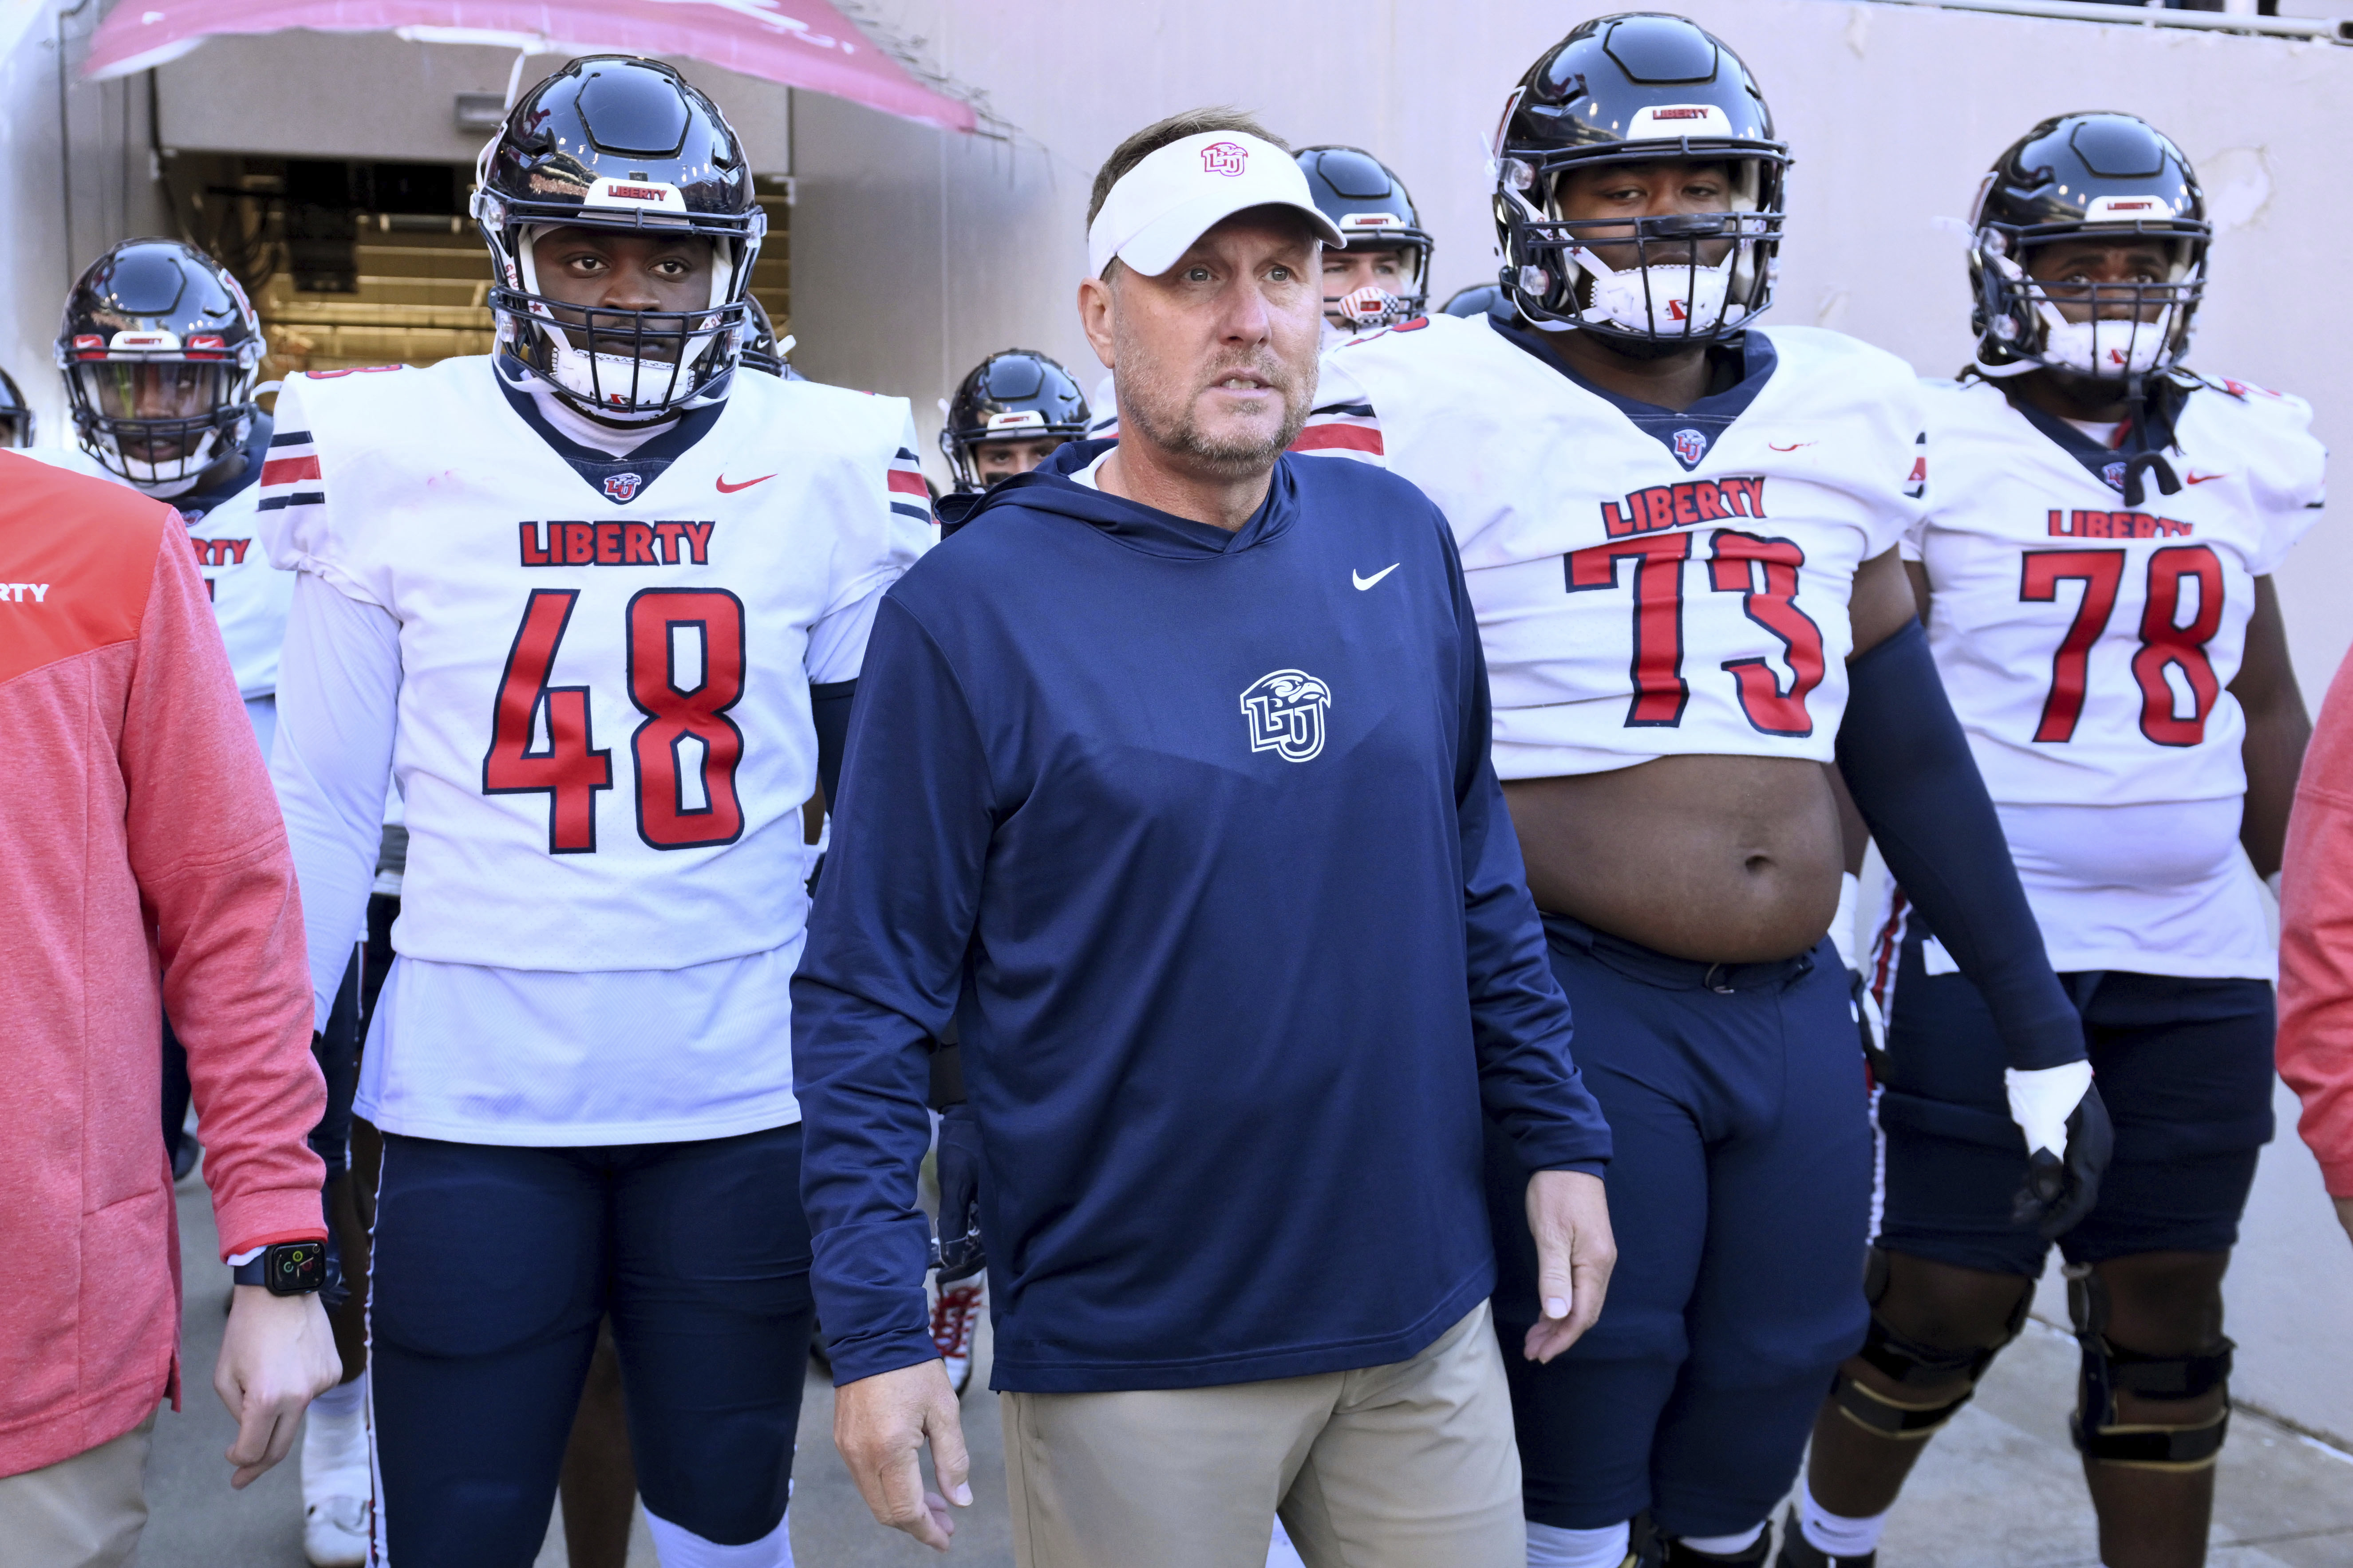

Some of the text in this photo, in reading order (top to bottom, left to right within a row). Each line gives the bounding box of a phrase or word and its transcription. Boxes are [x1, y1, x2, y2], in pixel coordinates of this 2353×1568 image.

[1652, 108, 1708, 120] LIBERTY
[608, 185, 667, 201] LIBERTY
[1601, 476, 1768, 540] LIBERTY
[2048, 509, 2194, 539] LIBERTY
[519, 520, 715, 567] LIBERTY
[1563, 528, 1825, 738] 73
[2019, 544, 2225, 747] 78
[482, 587, 746, 855] 48
